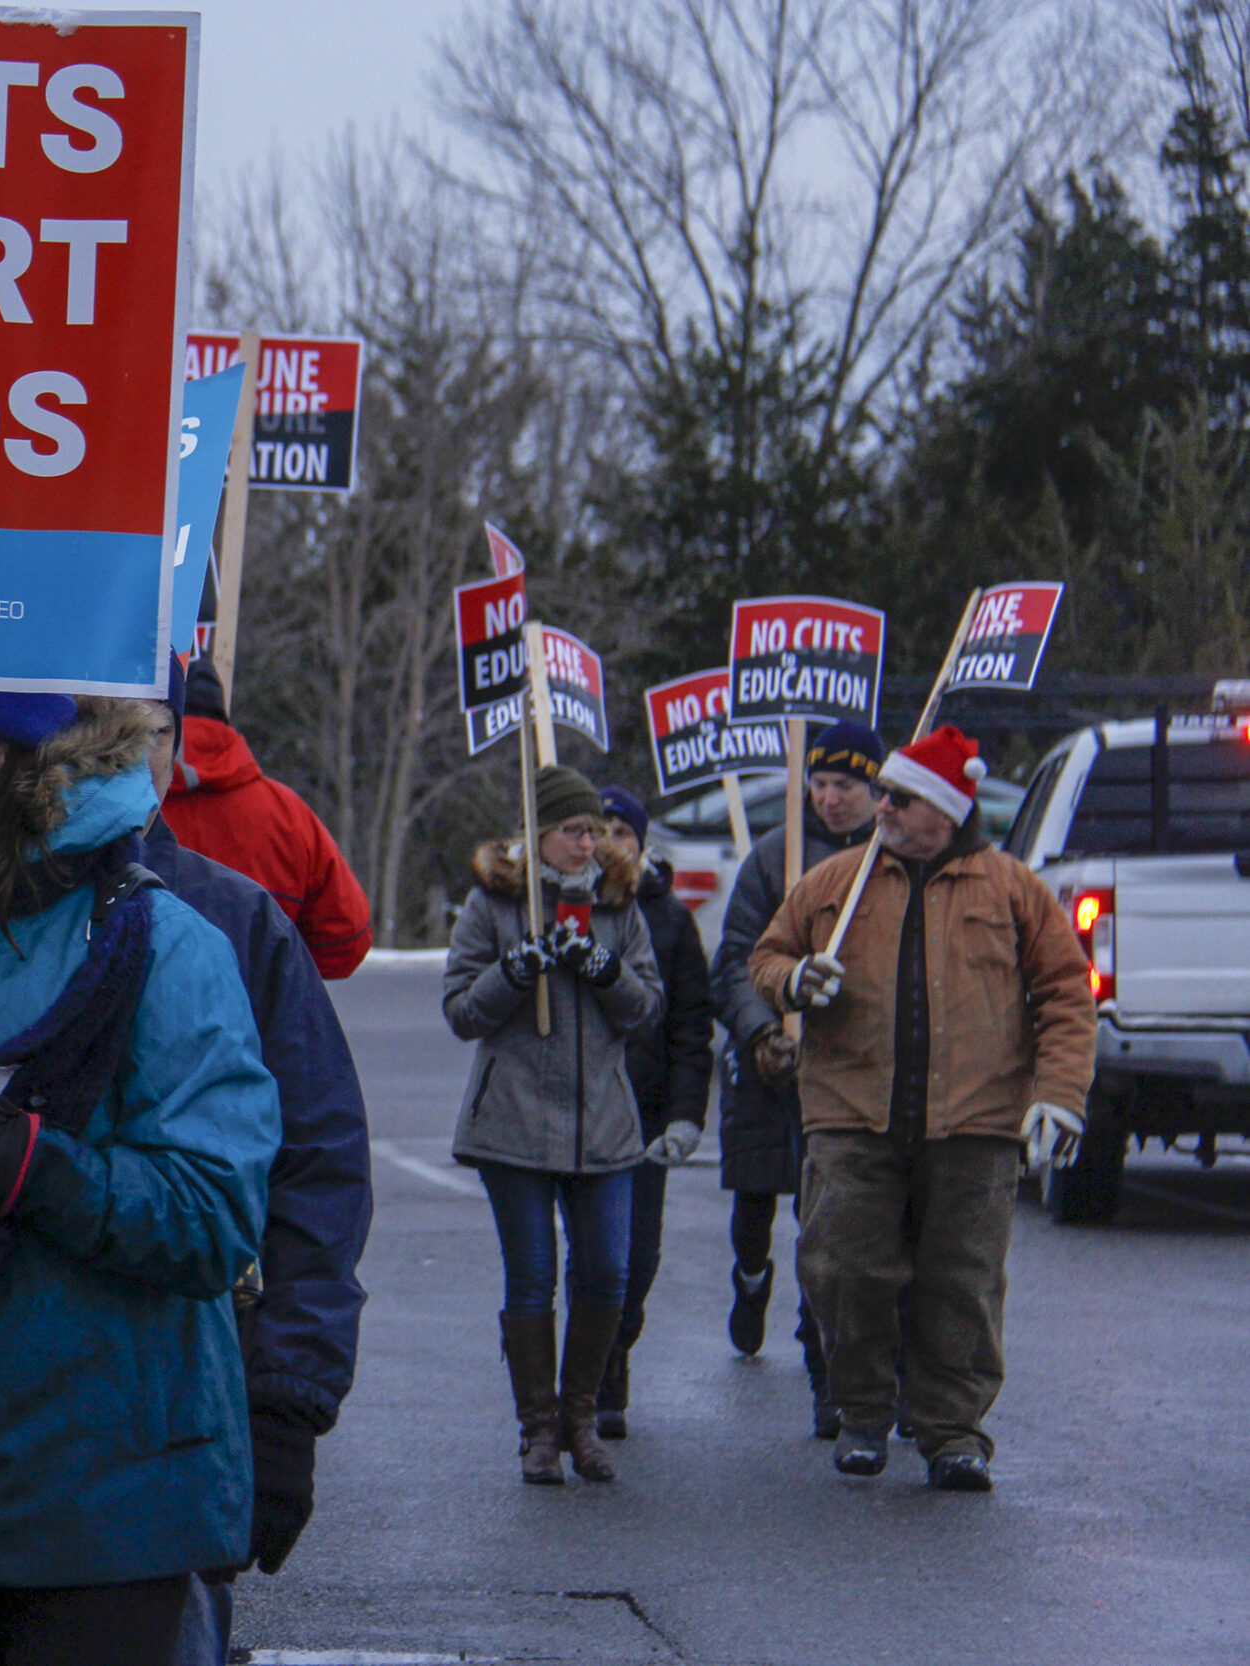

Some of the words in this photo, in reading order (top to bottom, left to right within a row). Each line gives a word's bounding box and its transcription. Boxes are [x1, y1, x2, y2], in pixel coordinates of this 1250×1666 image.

[751, 617, 787, 657] NO
[793, 616, 864, 662] CUTS
[781, 651, 798, 668] to
[739, 666, 868, 711] EDUCATION
[666, 694, 701, 733] NO
[664, 726, 782, 776] EDUCATION
